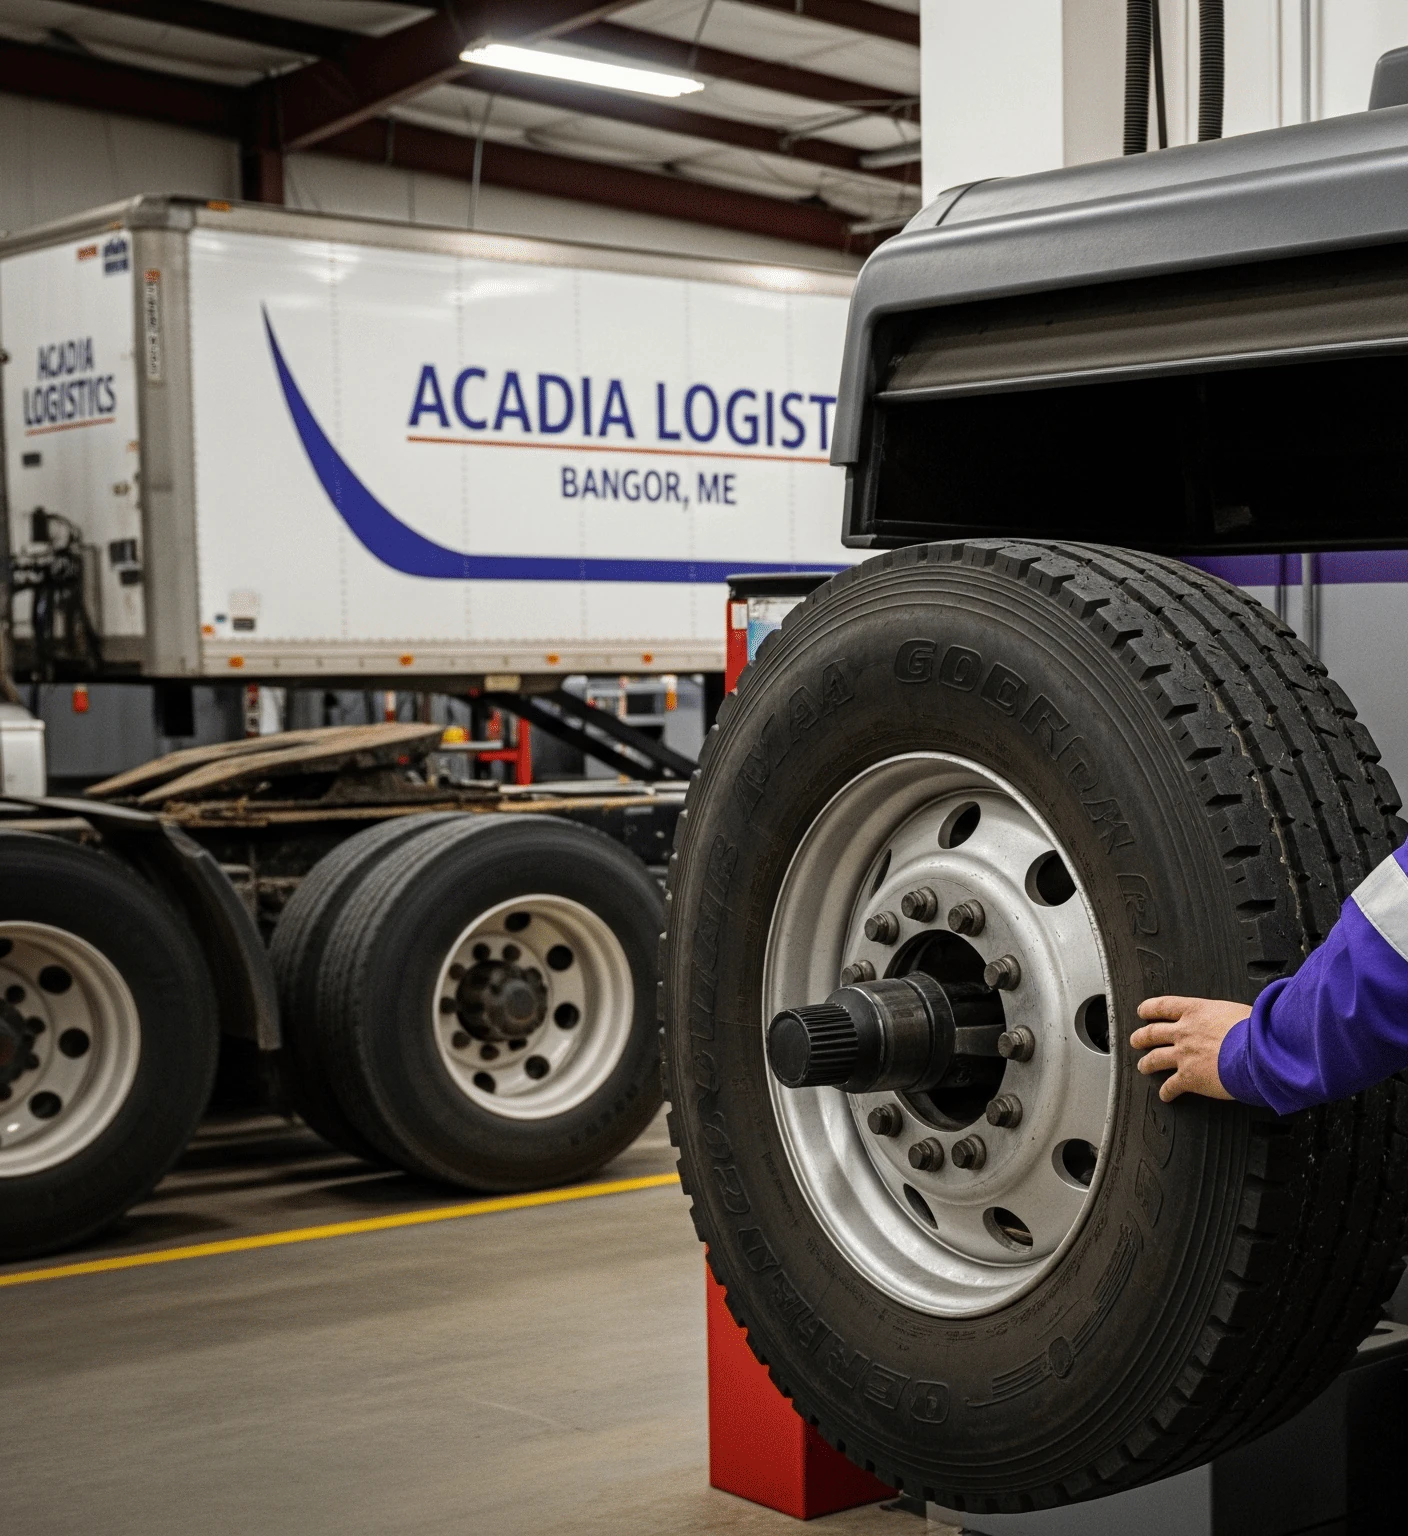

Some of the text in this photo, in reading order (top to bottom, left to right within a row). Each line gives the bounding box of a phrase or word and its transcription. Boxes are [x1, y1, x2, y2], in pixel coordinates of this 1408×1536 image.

[37, 336, 95, 379] ACADIA
[23, 374, 116, 428] LOGISTICS
[407, 364, 636, 439] ACADIA
[561, 466, 738, 513] BANGOR, ME
